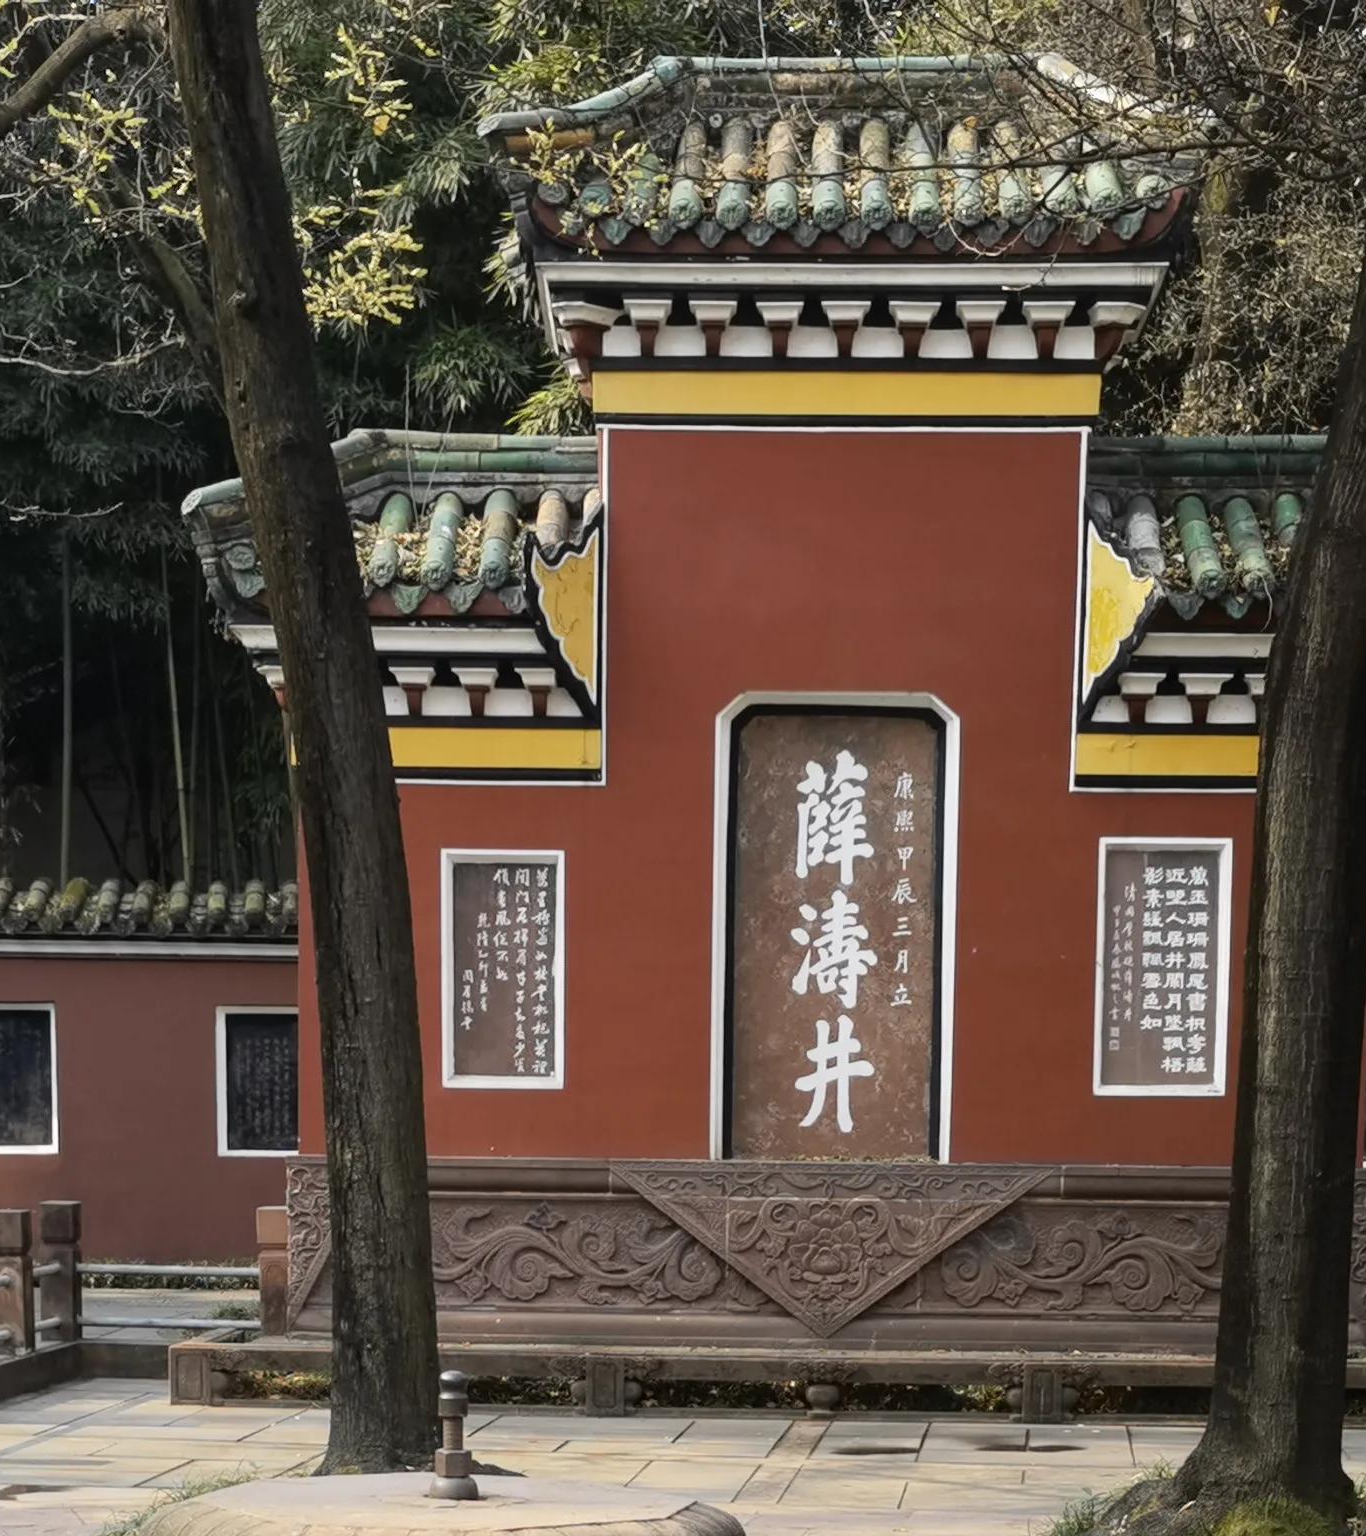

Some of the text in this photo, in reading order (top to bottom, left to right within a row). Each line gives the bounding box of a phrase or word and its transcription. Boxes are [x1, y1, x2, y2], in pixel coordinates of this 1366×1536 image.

[790, 749, 878, 1134] 薛濤井
[889, 771, 918, 1008] 康熙甲辰三月立
